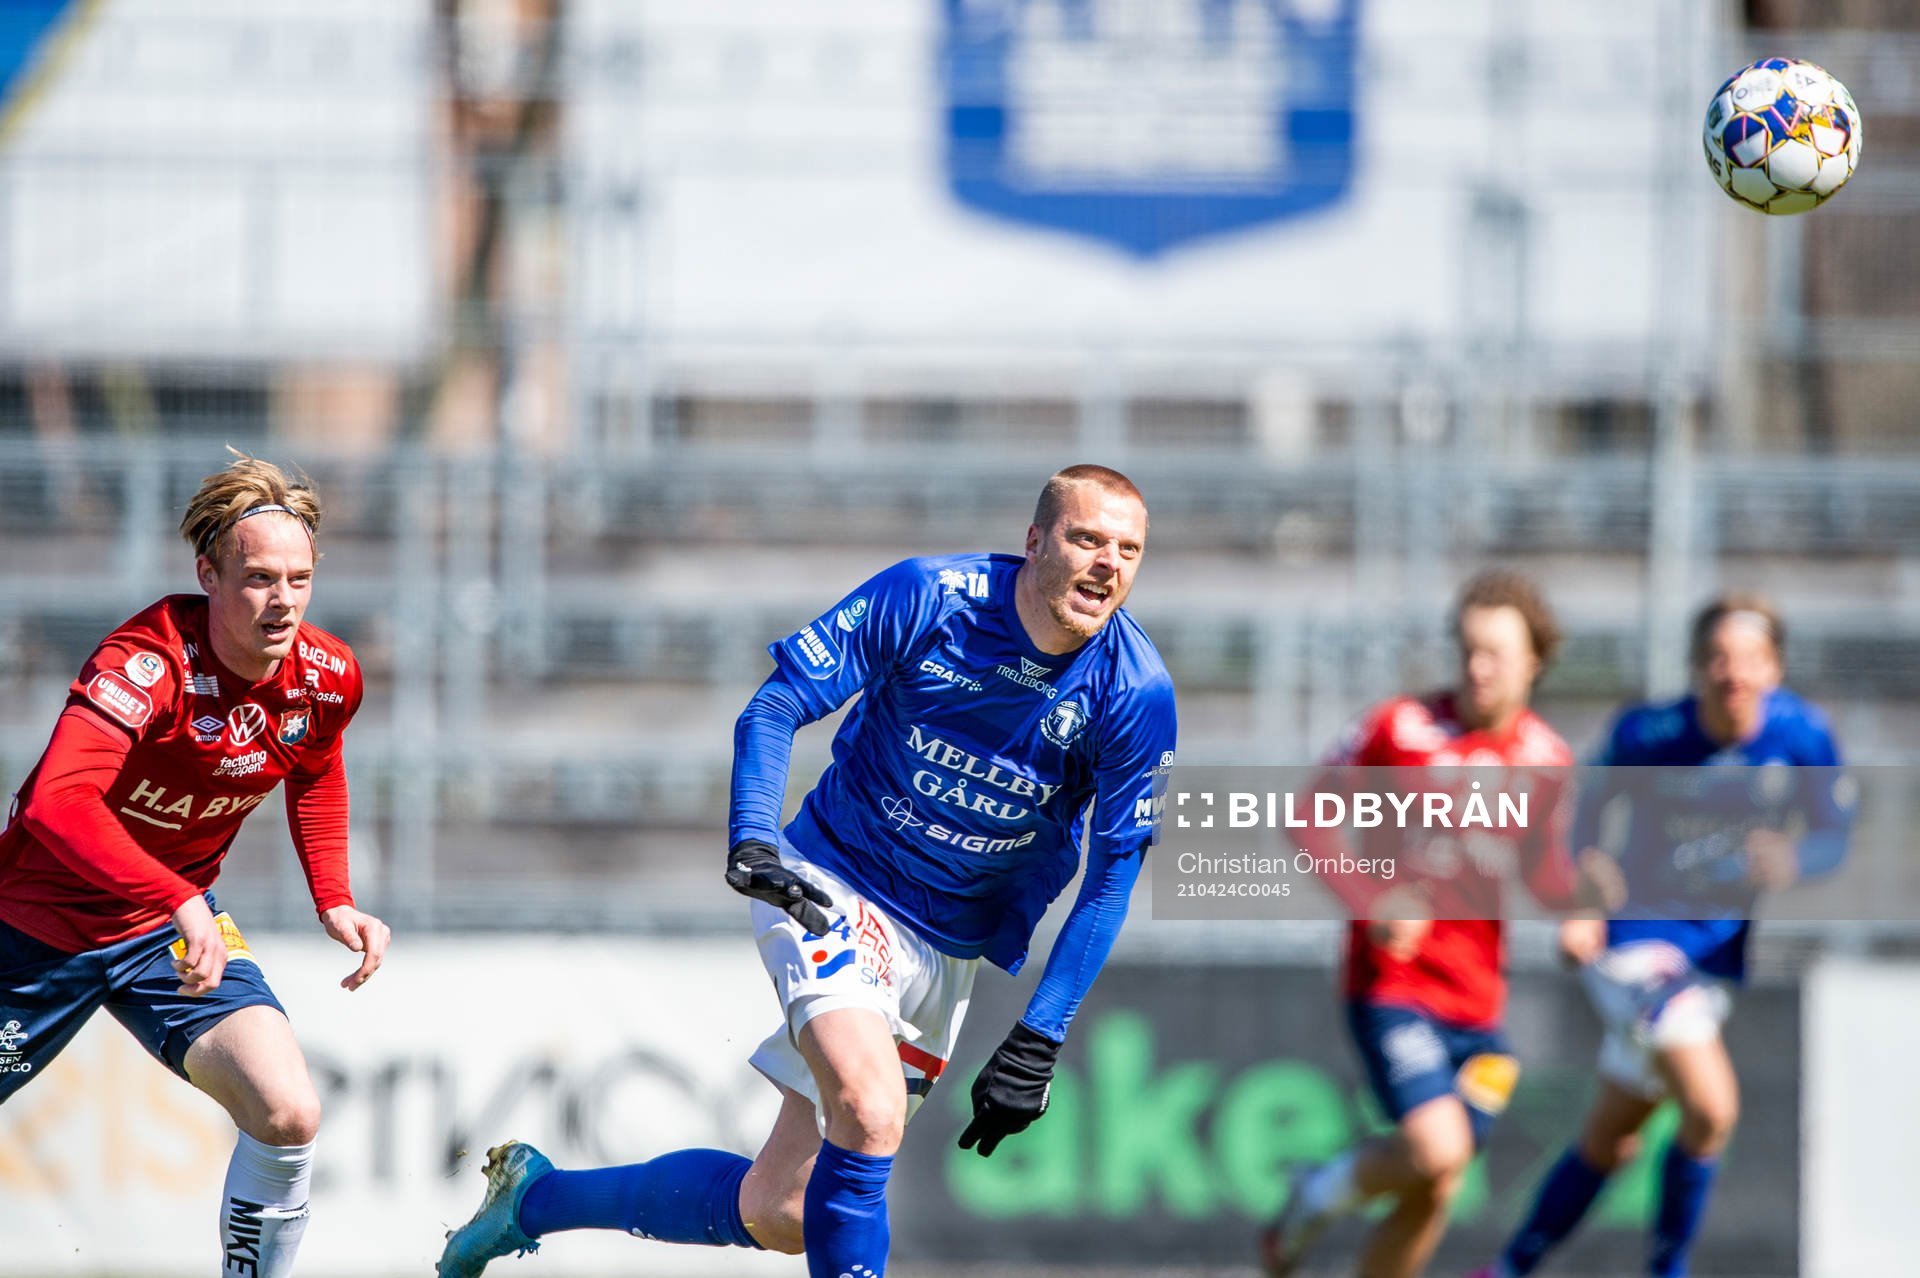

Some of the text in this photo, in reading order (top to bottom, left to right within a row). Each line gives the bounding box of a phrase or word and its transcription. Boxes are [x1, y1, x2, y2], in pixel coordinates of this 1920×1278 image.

[967, 572, 989, 598] TA
[298, 641, 346, 676] BJELIN
[800, 624, 836, 669] UNIBET
[919, 659, 972, 688] CRAFT
[996, 664, 1058, 700] TRELLEBORG
[97, 677, 147, 715] UNIBET
[286, 687, 344, 704] ERS ROSÉN
[195, 733, 222, 742] umbro
[220, 750, 267, 768] factoring
[906, 724, 1063, 806] MELLBY
[128, 778, 194, 818] H.A
[912, 769, 1029, 821] GÅRD
